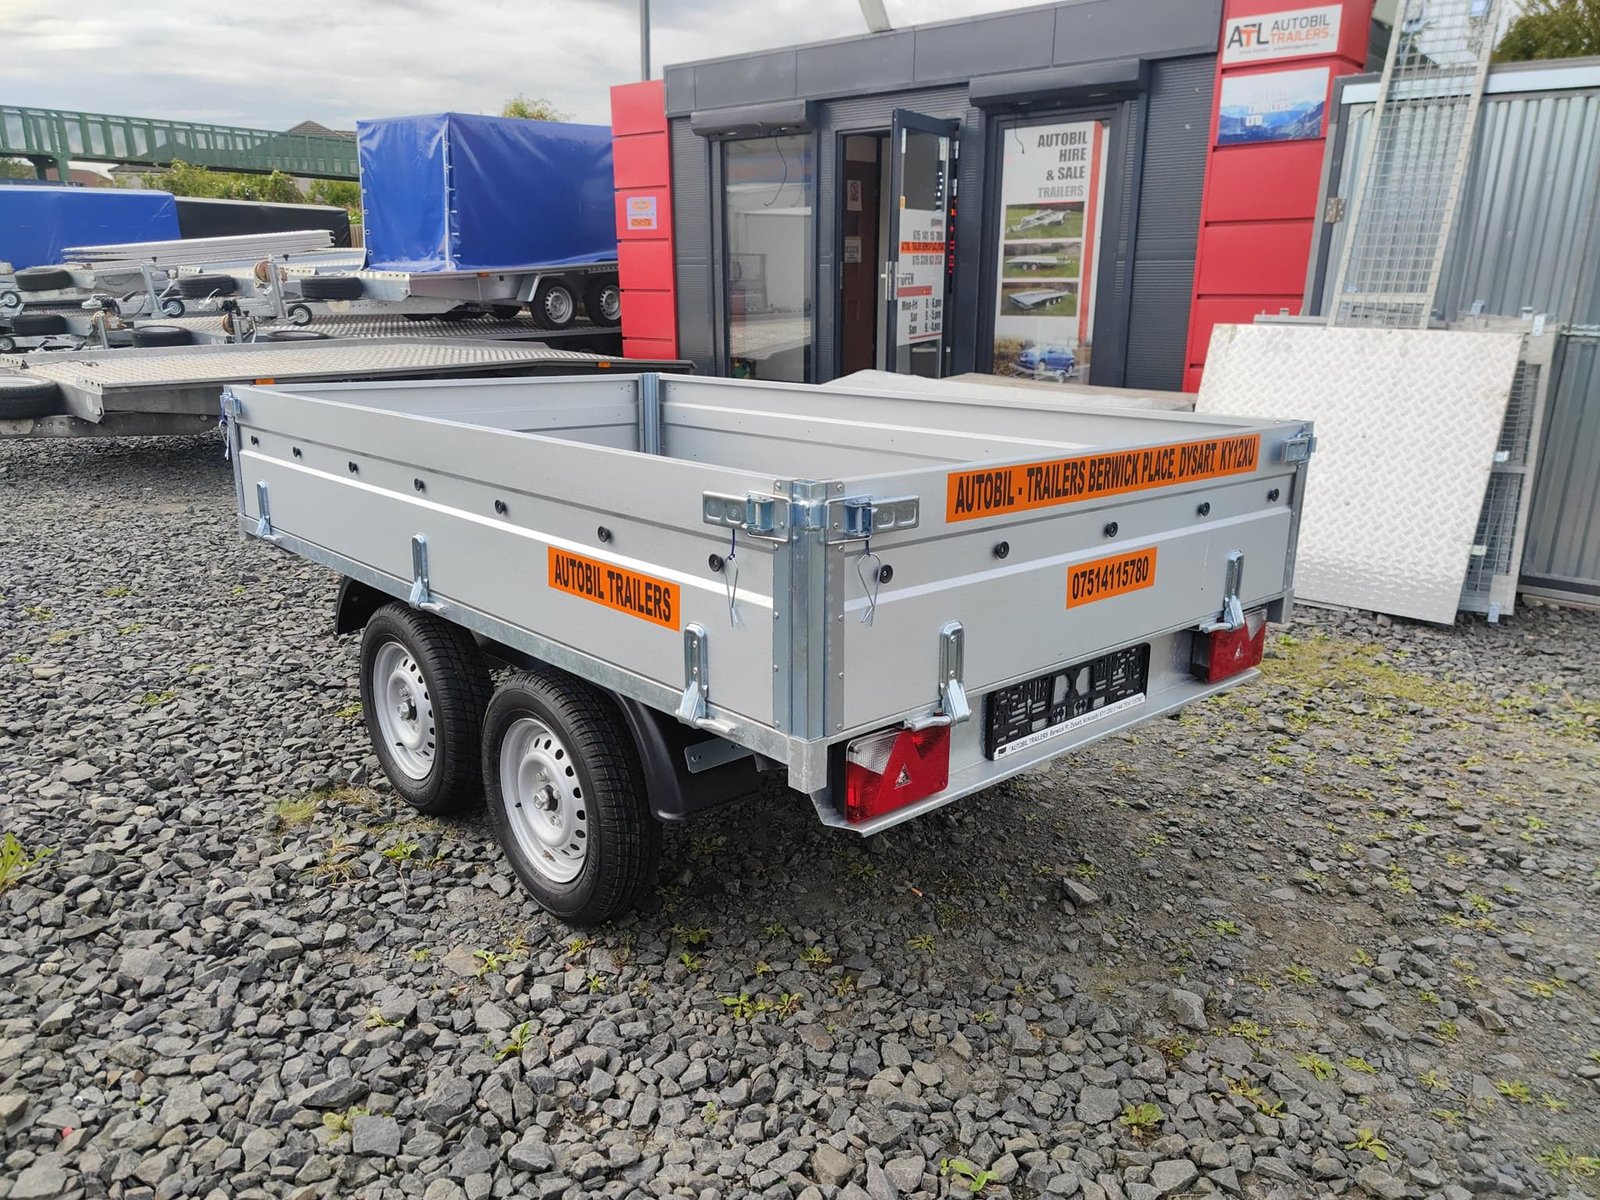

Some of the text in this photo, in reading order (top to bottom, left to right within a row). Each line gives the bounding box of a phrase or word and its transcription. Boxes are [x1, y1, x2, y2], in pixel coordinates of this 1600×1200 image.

[1270, 14, 1330, 31] AUTOBIL
[1227, 22, 1269, 49] ATL
[1270, 27, 1329, 45] TRAILERS
[1037, 131, 1088, 148] AUTOBIL
[1059, 148, 1087, 162] HIRE
[1046, 165, 1086, 181] & SALE
[1038, 185, 1084, 198] TRAILERS
[954, 470, 1015, 514] AUTOBIL
[1027, 458, 1086, 502] TRAILERS
[1088, 451, 1140, 493] BERWICK
[1142, 448, 1176, 484] PLACE,
[1178, 443, 1216, 477] DYSART,
[1220, 438, 1257, 471] KY12XU
[1072, 556, 1149, 600] 07514115780
[554, 554, 671, 622] AUTOBIL TRAILERS
[1029, 730, 1049, 744] TRAILERS
